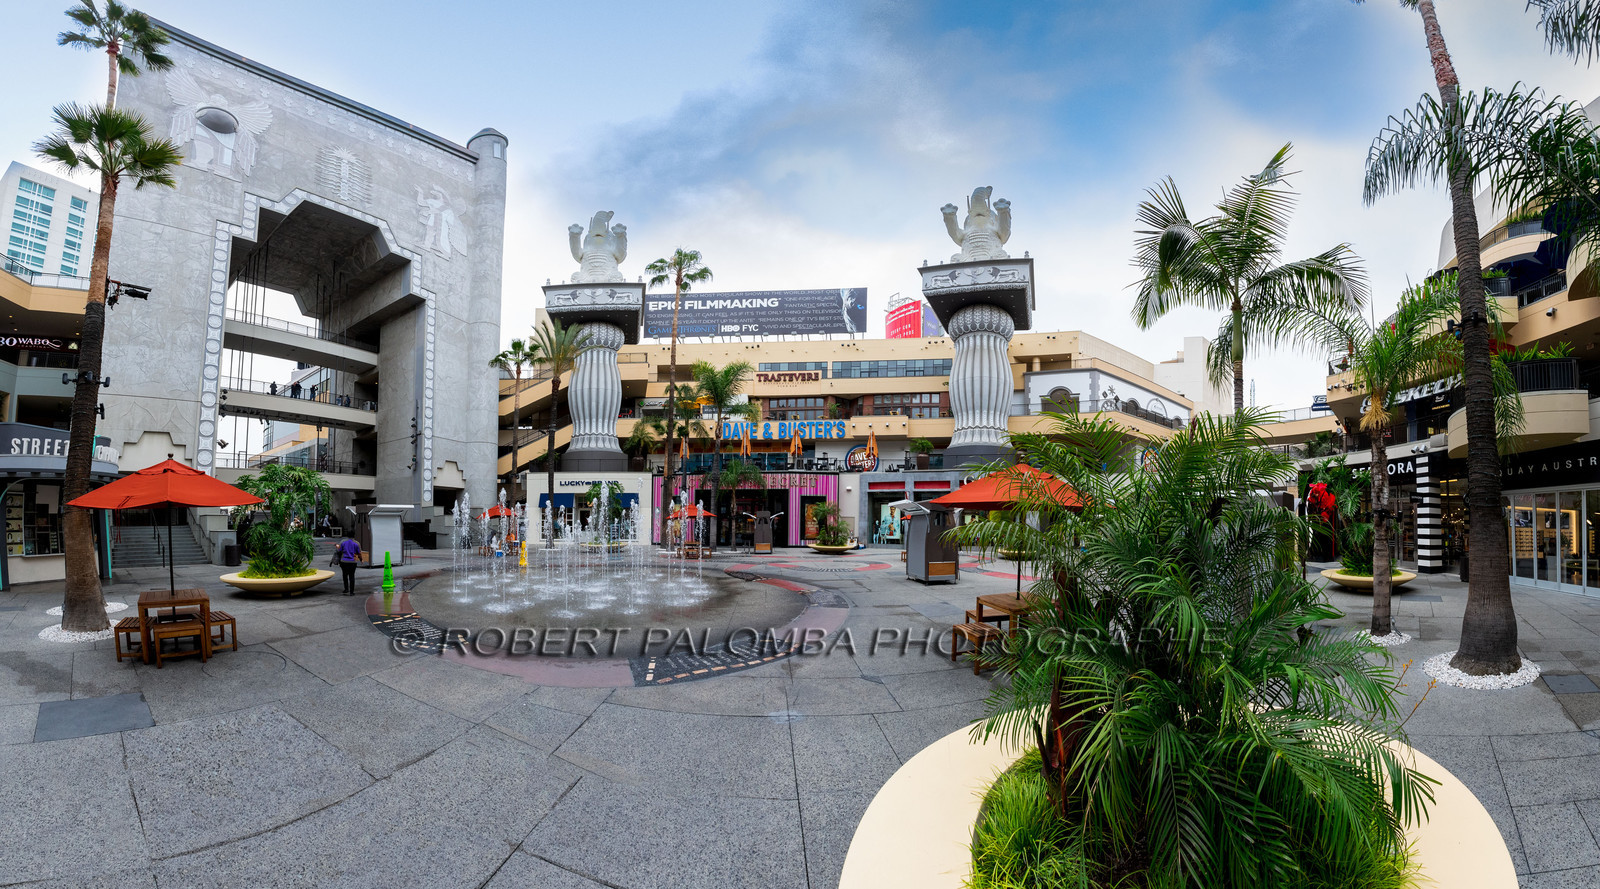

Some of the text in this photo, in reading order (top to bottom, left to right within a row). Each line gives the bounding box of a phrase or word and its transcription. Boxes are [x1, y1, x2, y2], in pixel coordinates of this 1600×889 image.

[18, 337, 50, 346] WABO
[756, 372, 819, 382] TRASTEVERE
[722, 421, 846, 439] DAVE & BUSTER'S
